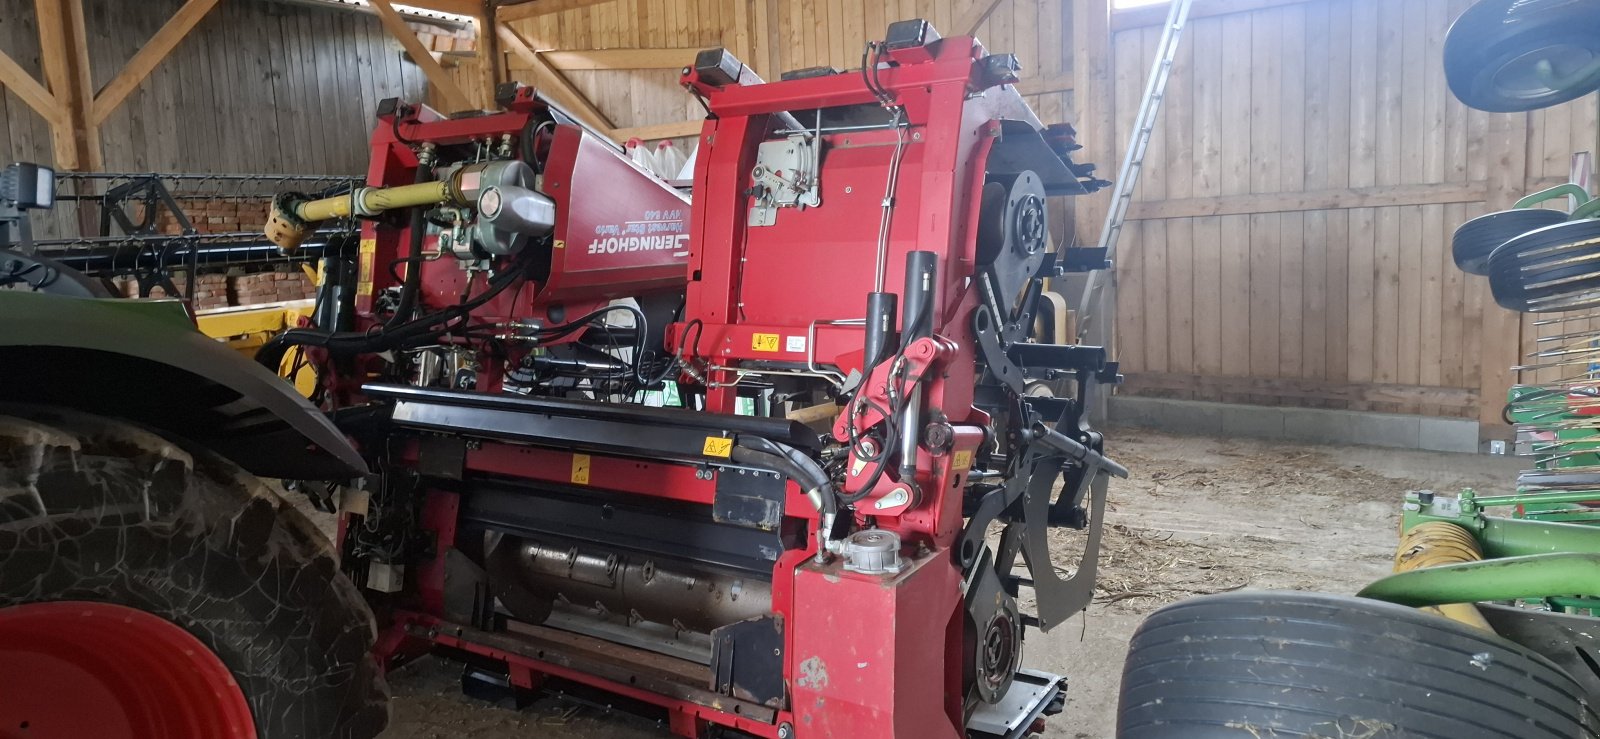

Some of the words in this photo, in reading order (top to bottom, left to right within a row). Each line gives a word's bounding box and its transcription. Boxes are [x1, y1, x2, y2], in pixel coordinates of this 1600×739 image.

[595, 224, 620, 236] Vario
[647, 222, 683, 233] Harvest
[588, 234, 690, 257] GERINGHOFF
